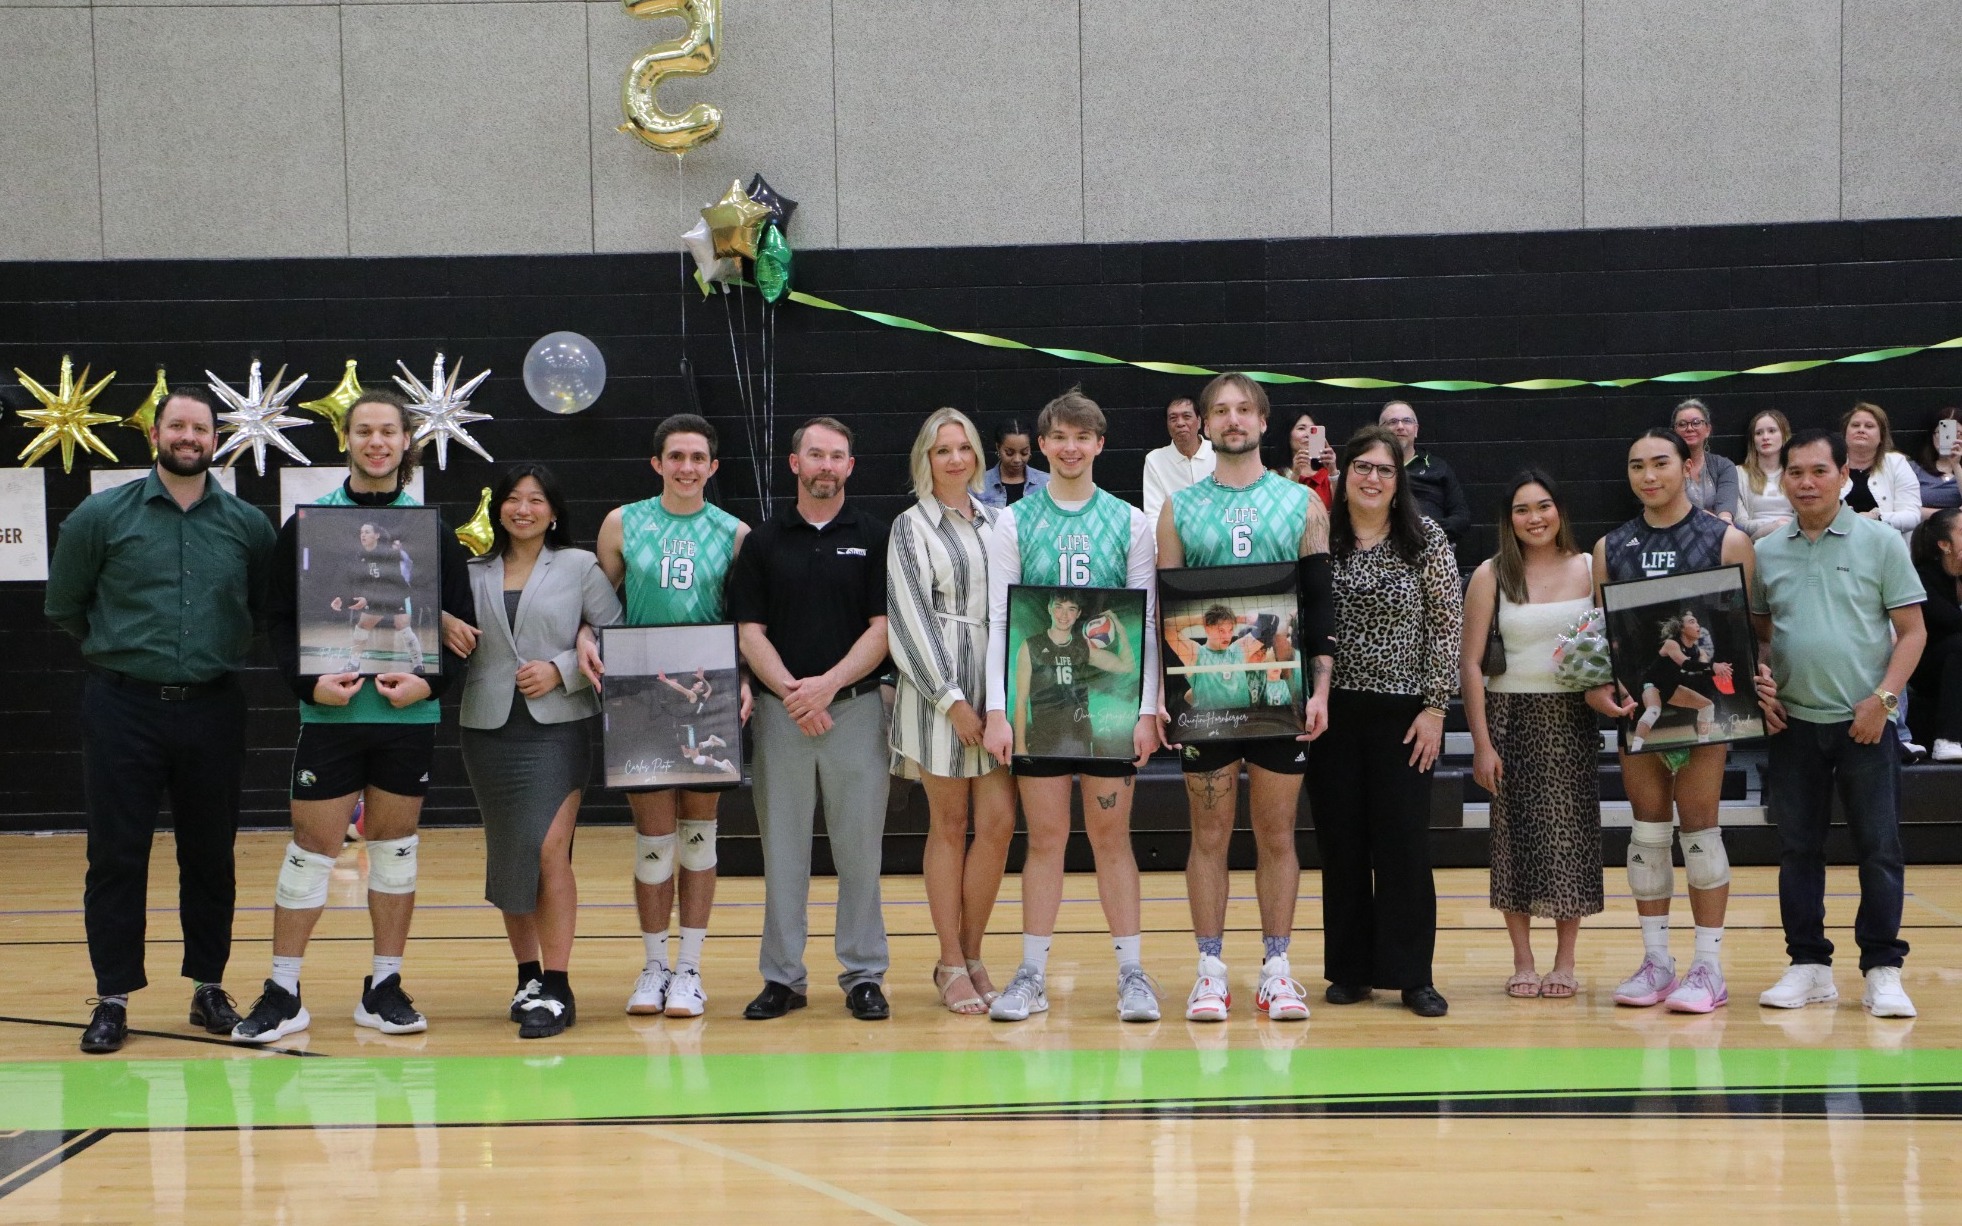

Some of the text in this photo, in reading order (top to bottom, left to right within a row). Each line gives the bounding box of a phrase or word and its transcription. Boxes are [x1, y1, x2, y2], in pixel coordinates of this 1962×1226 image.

[1224, 507, 1258, 524] LIFE
[662, 538, 696, 557] LIFE
[1058, 534, 1090, 551] LIFE
[1231, 524, 1253, 559] 6
[1058, 552, 1091, 587] 16
[1642, 551, 1676, 569] LIFE
[660, 556, 695, 591] 13
[1055, 656, 1072, 666] LIFE
[1055, 665, 1072, 685] 16
